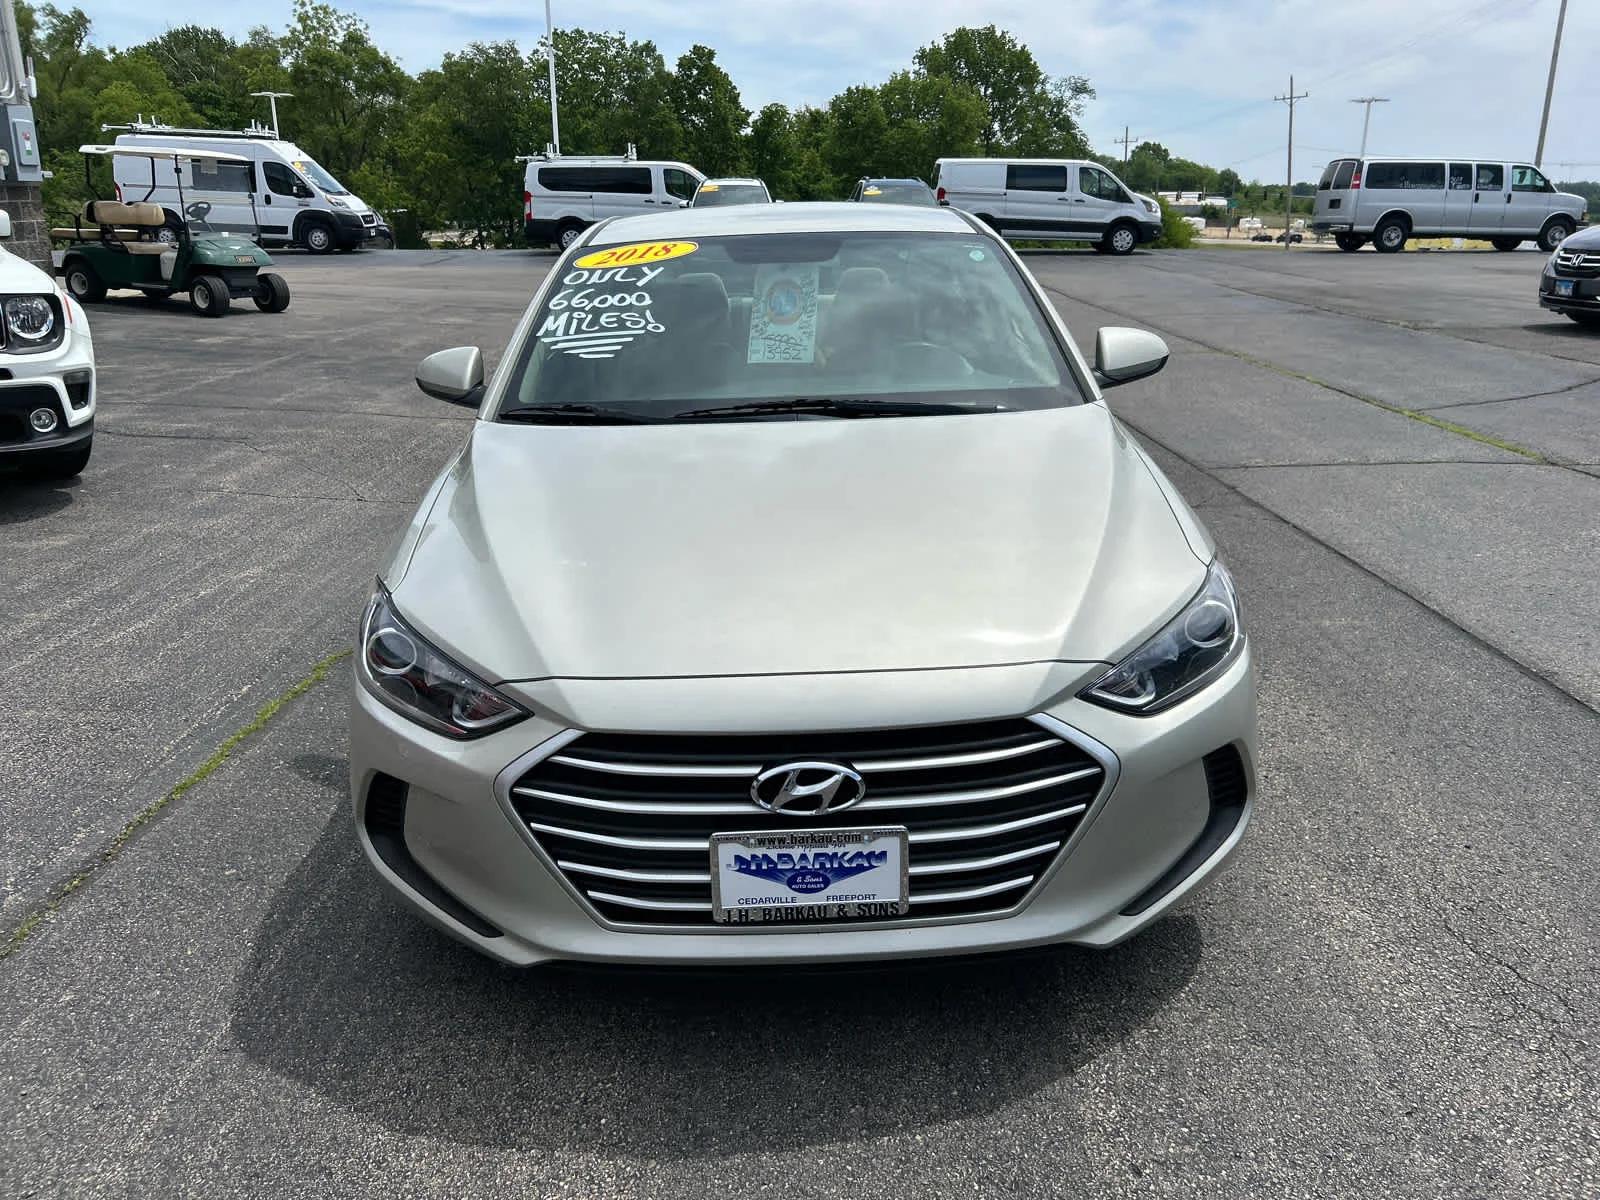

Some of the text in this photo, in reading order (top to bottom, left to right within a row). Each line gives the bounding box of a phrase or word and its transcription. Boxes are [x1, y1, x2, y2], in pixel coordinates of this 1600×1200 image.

[593, 243, 678, 266] 2018
[563, 266, 665, 287] ONLY
[548, 288, 653, 312] 66,000
[757, 832, 862, 846] www.barkau.com
[737, 893, 877, 905] CEDARVILLE FREEPORT
[762, 906, 827, 921] BARKAU
[837, 904, 849, 917] &
[858, 902, 899, 917] SONS
